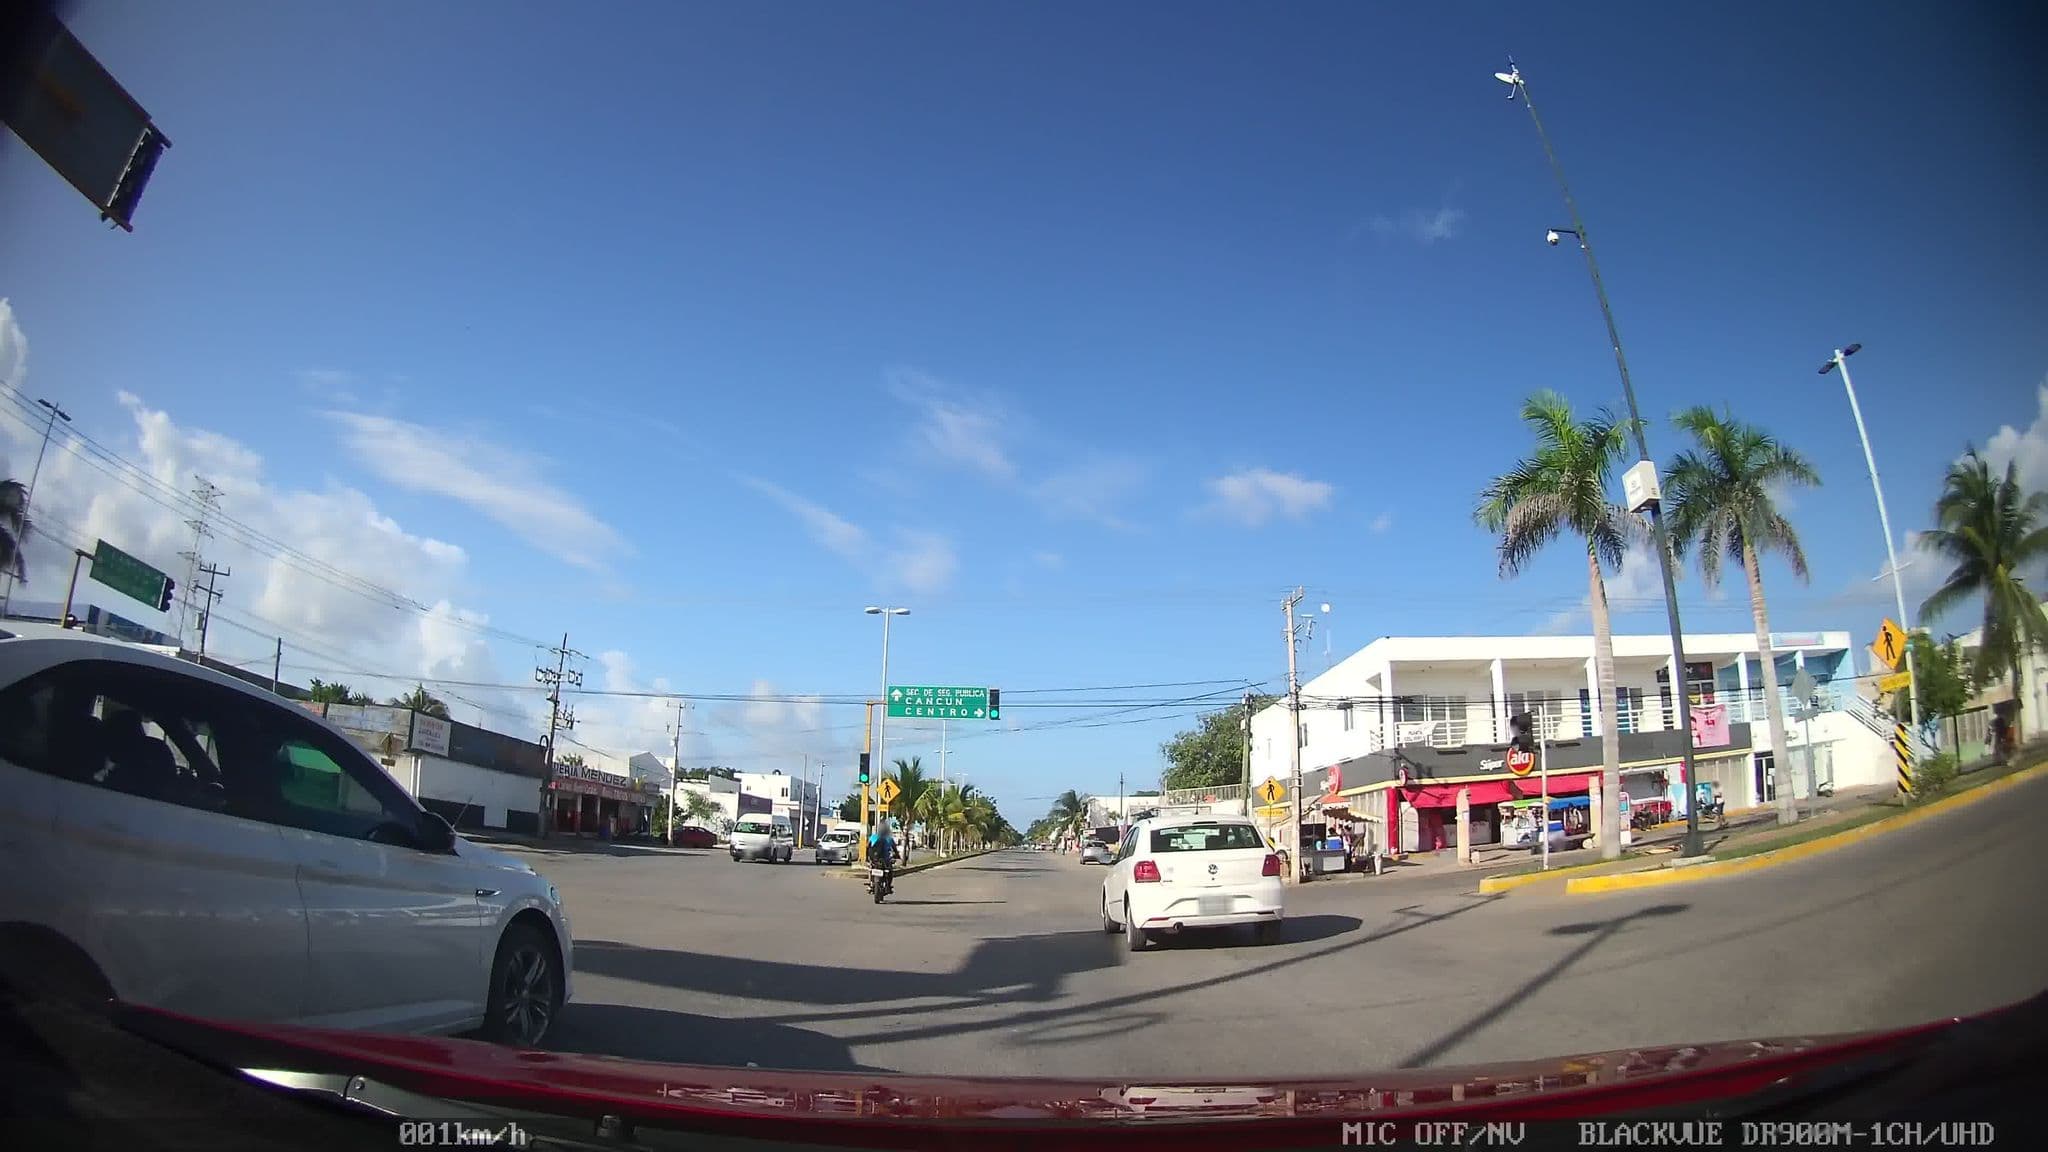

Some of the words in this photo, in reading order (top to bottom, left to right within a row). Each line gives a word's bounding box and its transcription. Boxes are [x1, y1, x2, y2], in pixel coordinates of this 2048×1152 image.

[923, 688, 934, 697] DE
[955, 689, 985, 698] PUBLICA
[905, 697, 963, 706] CANCUN
[905, 707, 968, 717] CENTRO
[581, 767, 627, 787] MENDEZ
